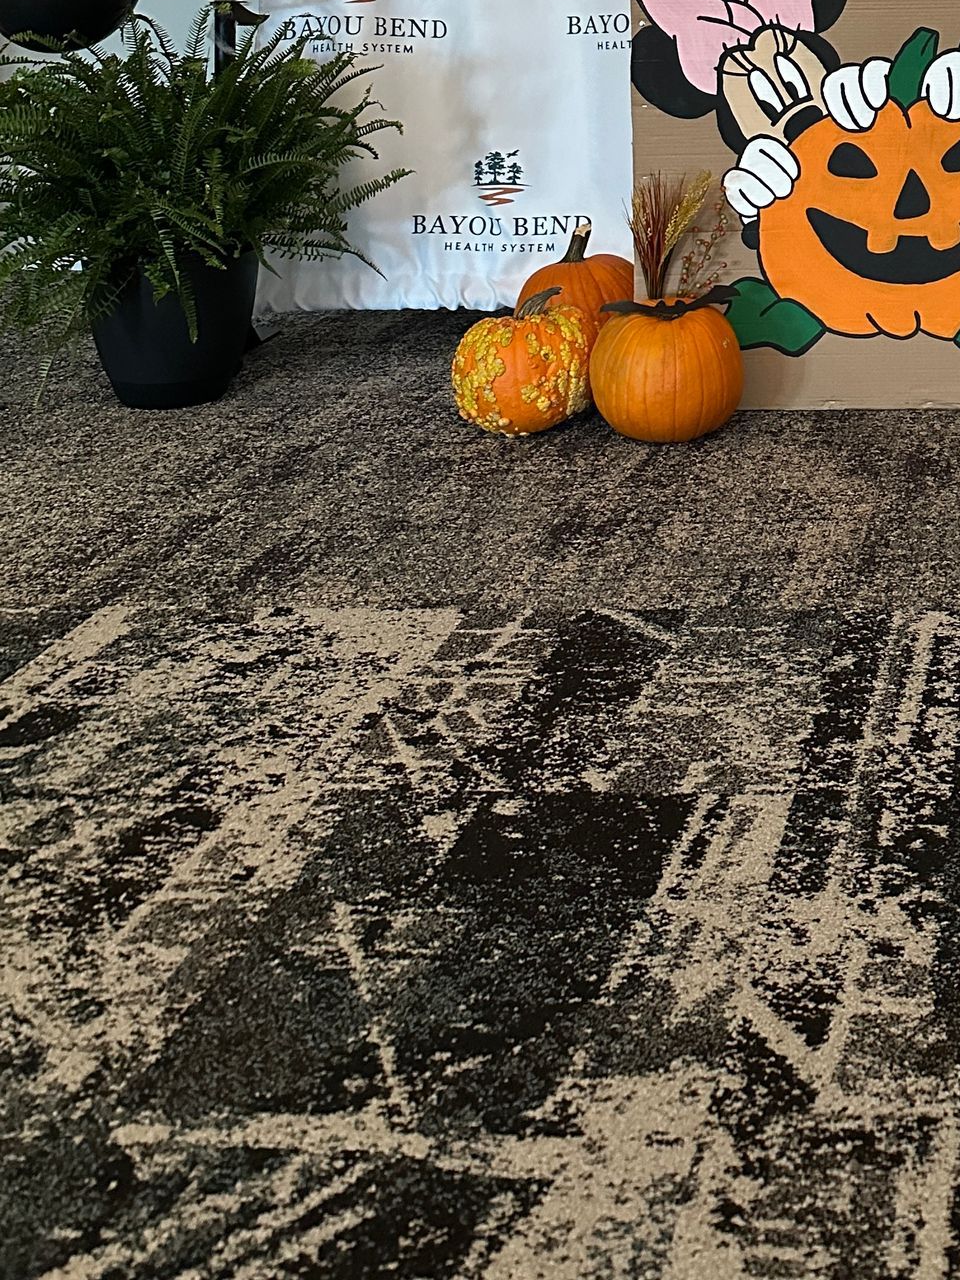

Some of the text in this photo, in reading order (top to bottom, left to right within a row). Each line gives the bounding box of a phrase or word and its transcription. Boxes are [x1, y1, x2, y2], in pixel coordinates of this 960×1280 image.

[281, 15, 447, 40] BAYOU BEND
[566, 14, 630, 34] BAYO
[312, 43, 413, 53] HEALTH SYSTEM
[597, 40, 632, 50] HEALT
[412, 215, 502, 236] BAYOU
[444, 242, 555, 252] HEALTH SYSTEM
